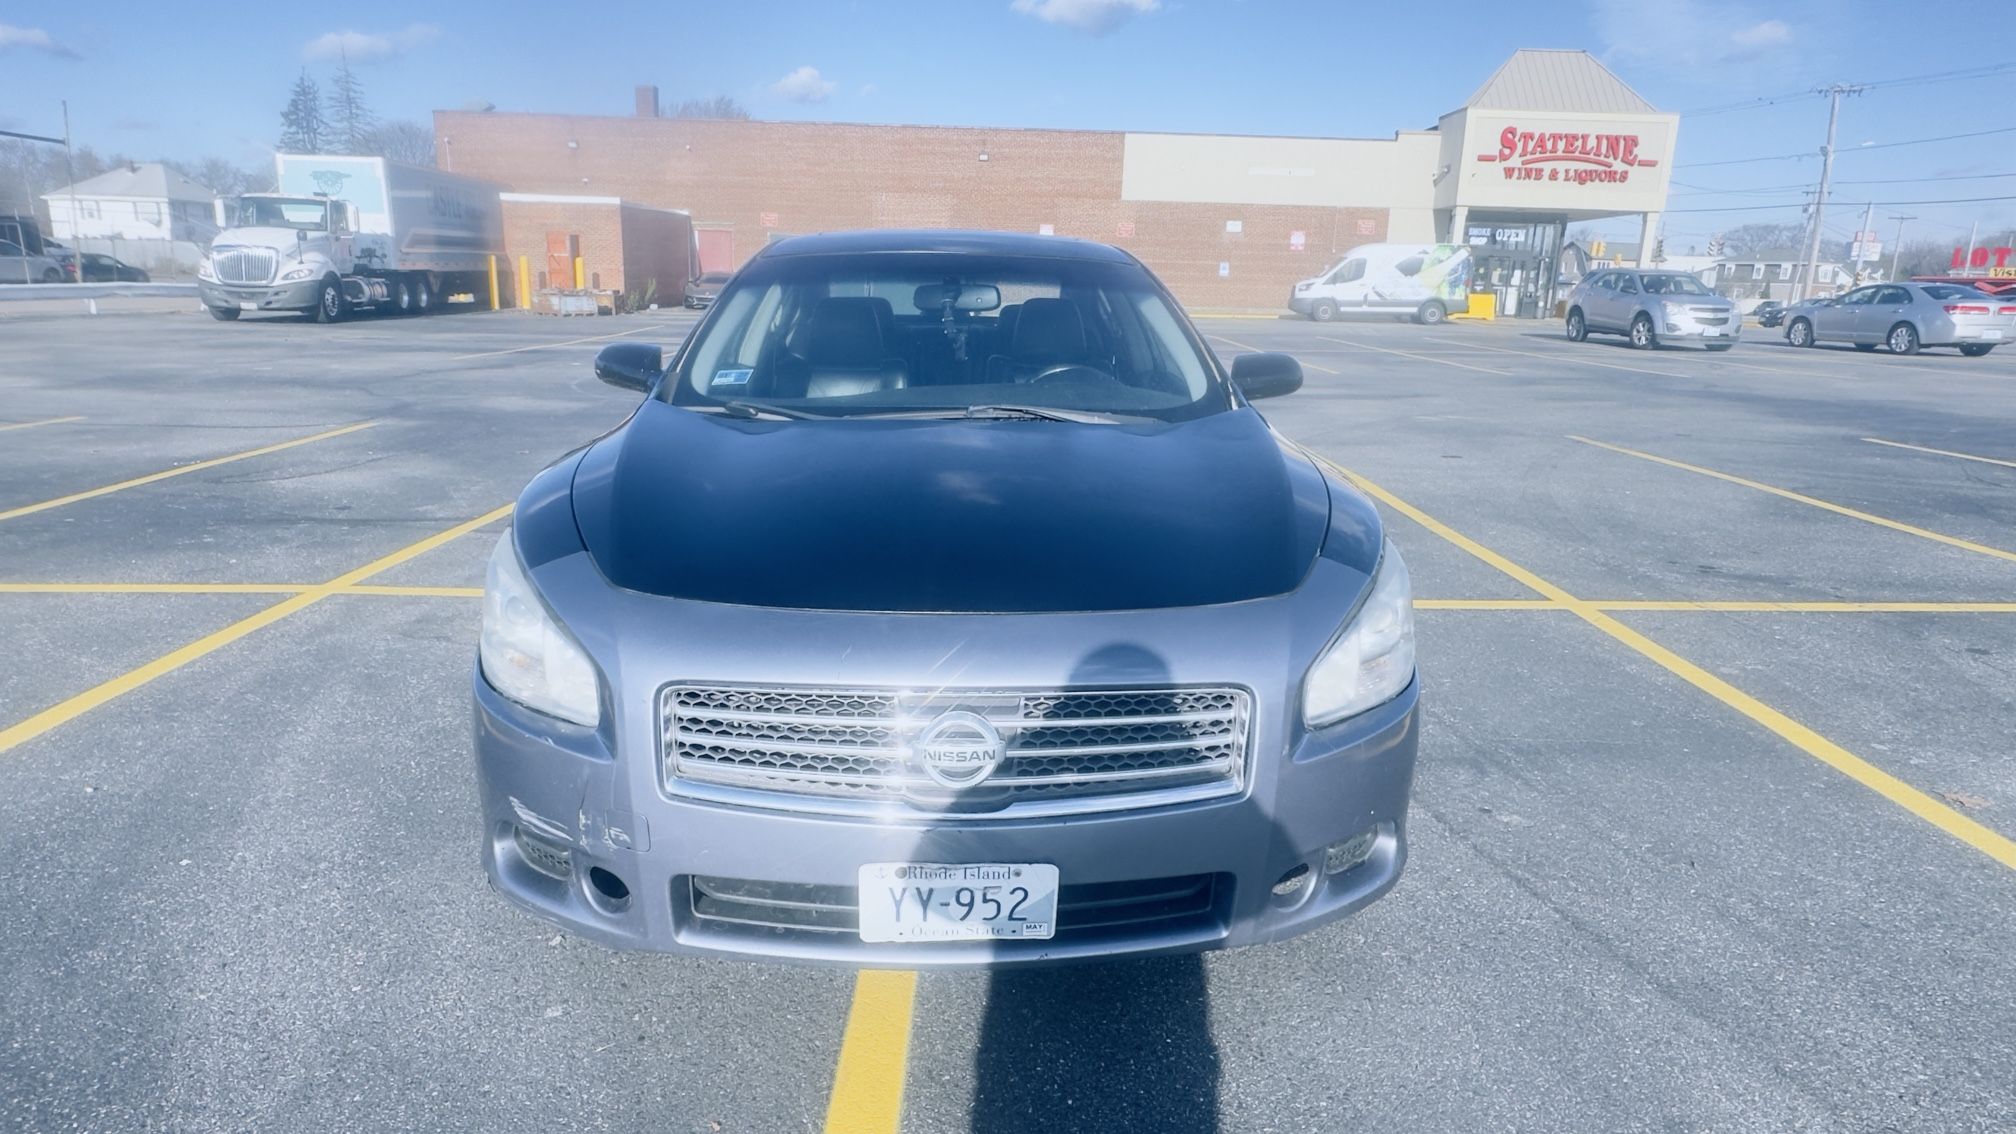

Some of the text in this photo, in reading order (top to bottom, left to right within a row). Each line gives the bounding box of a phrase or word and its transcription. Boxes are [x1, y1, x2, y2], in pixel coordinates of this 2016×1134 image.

[1499, 126, 1640, 166] STATELINE
[1504, 167, 1629, 185] WINE & LIQUORS
[1496, 228, 1526, 242] OPEN
[1951, 246, 2013, 267] LOT
[924, 749, 995, 762] NISSAN
[908, 865, 1011, 880] Rhode Island
[888, 886, 1029, 922] YY-952
[965, 924, 1004, 936] State
